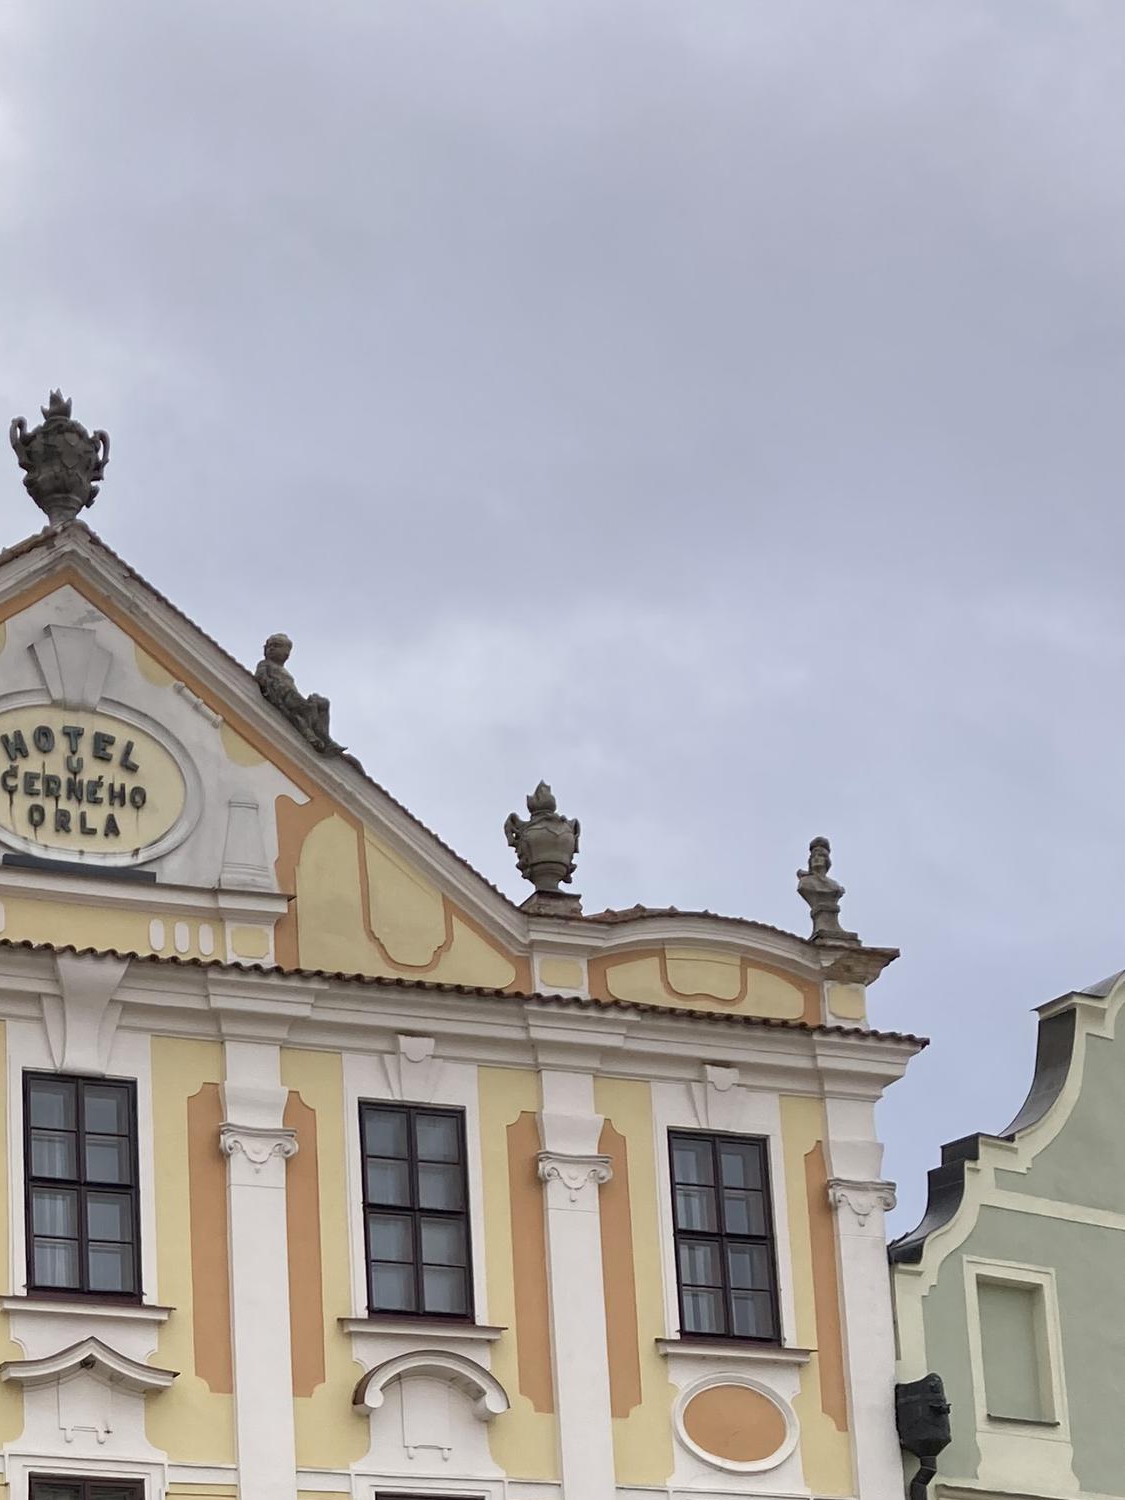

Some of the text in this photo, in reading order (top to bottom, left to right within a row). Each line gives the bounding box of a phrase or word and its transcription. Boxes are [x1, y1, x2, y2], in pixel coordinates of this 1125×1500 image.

[0, 725, 140, 774] HOTEL
[66, 755, 84, 775] U
[0, 764, 147, 809] ČERNÉHO
[28, 804, 121, 838] ORLA
